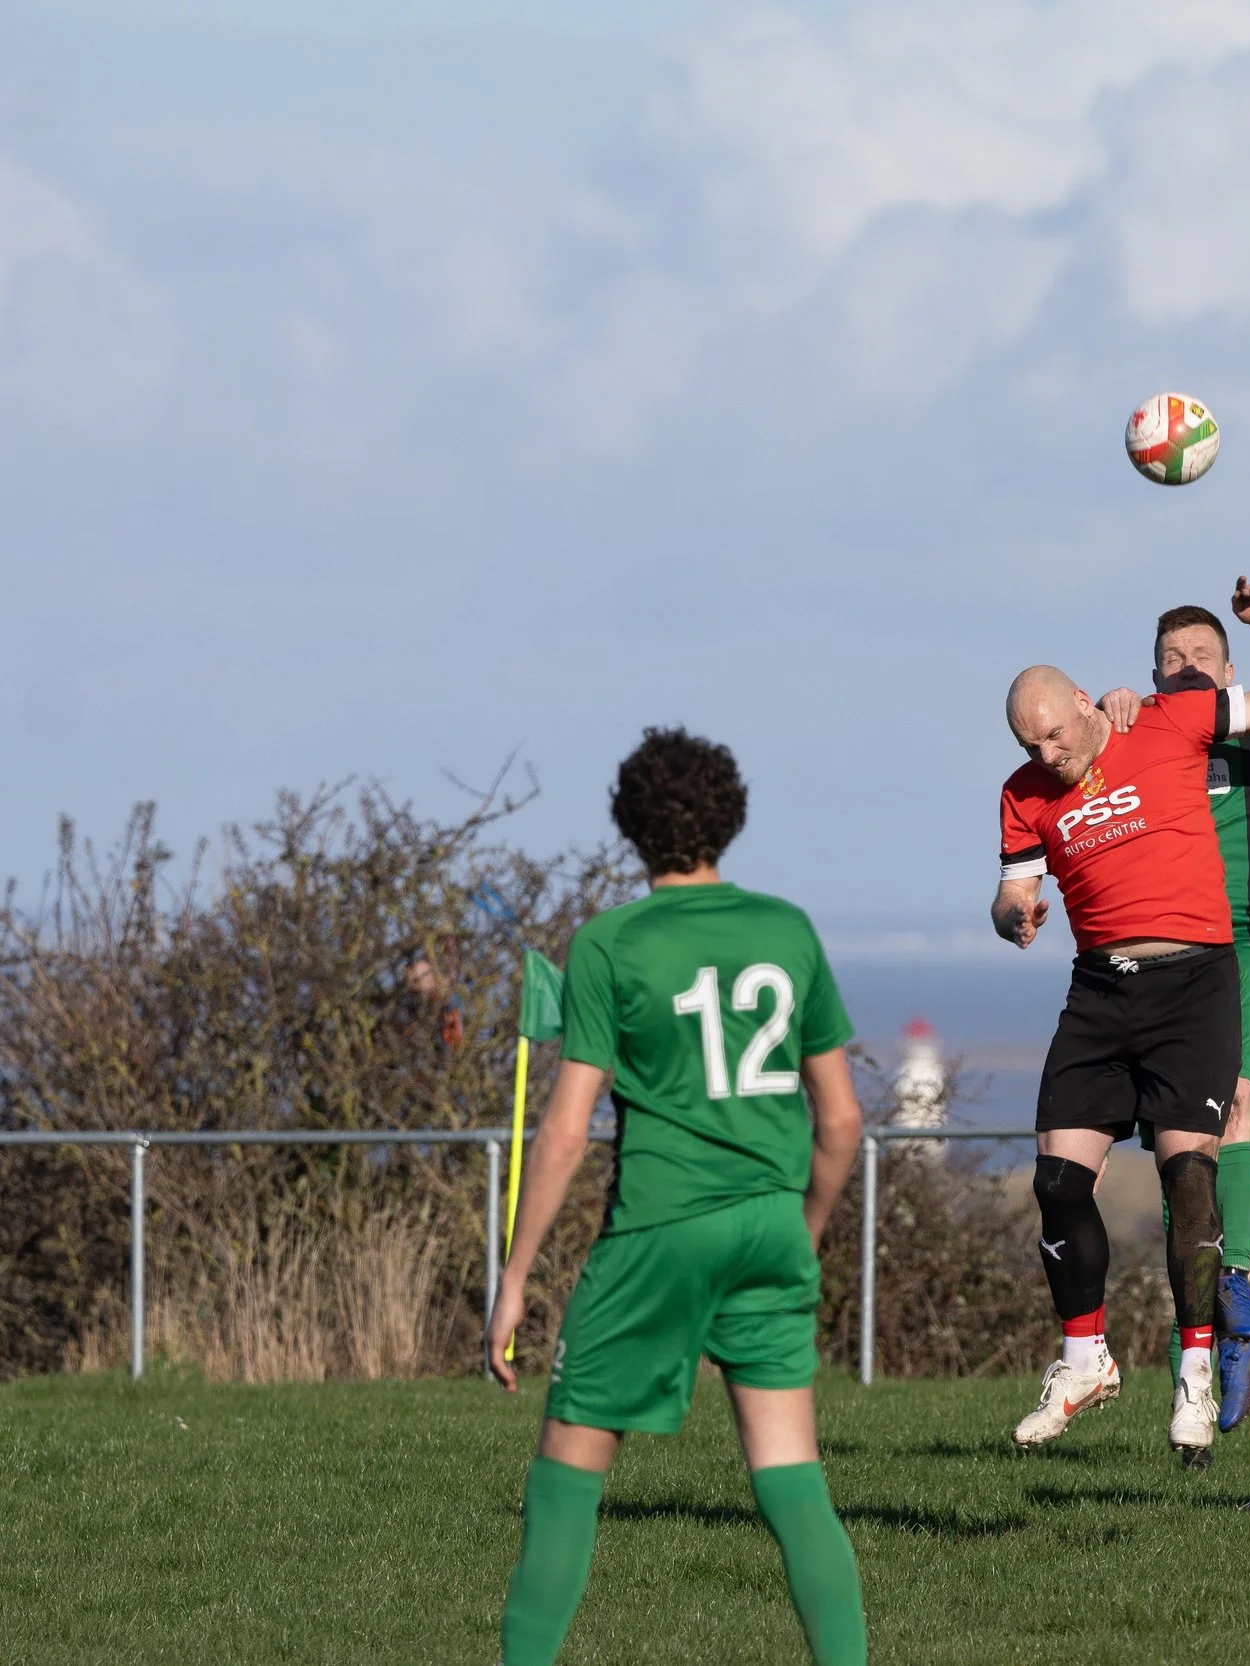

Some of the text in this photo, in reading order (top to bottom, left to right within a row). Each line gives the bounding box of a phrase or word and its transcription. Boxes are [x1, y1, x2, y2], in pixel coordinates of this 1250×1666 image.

[1056, 785, 1141, 842] PSS
[1064, 817, 1147, 858] AUTO CENTRE
[672, 962, 800, 1100] 12
